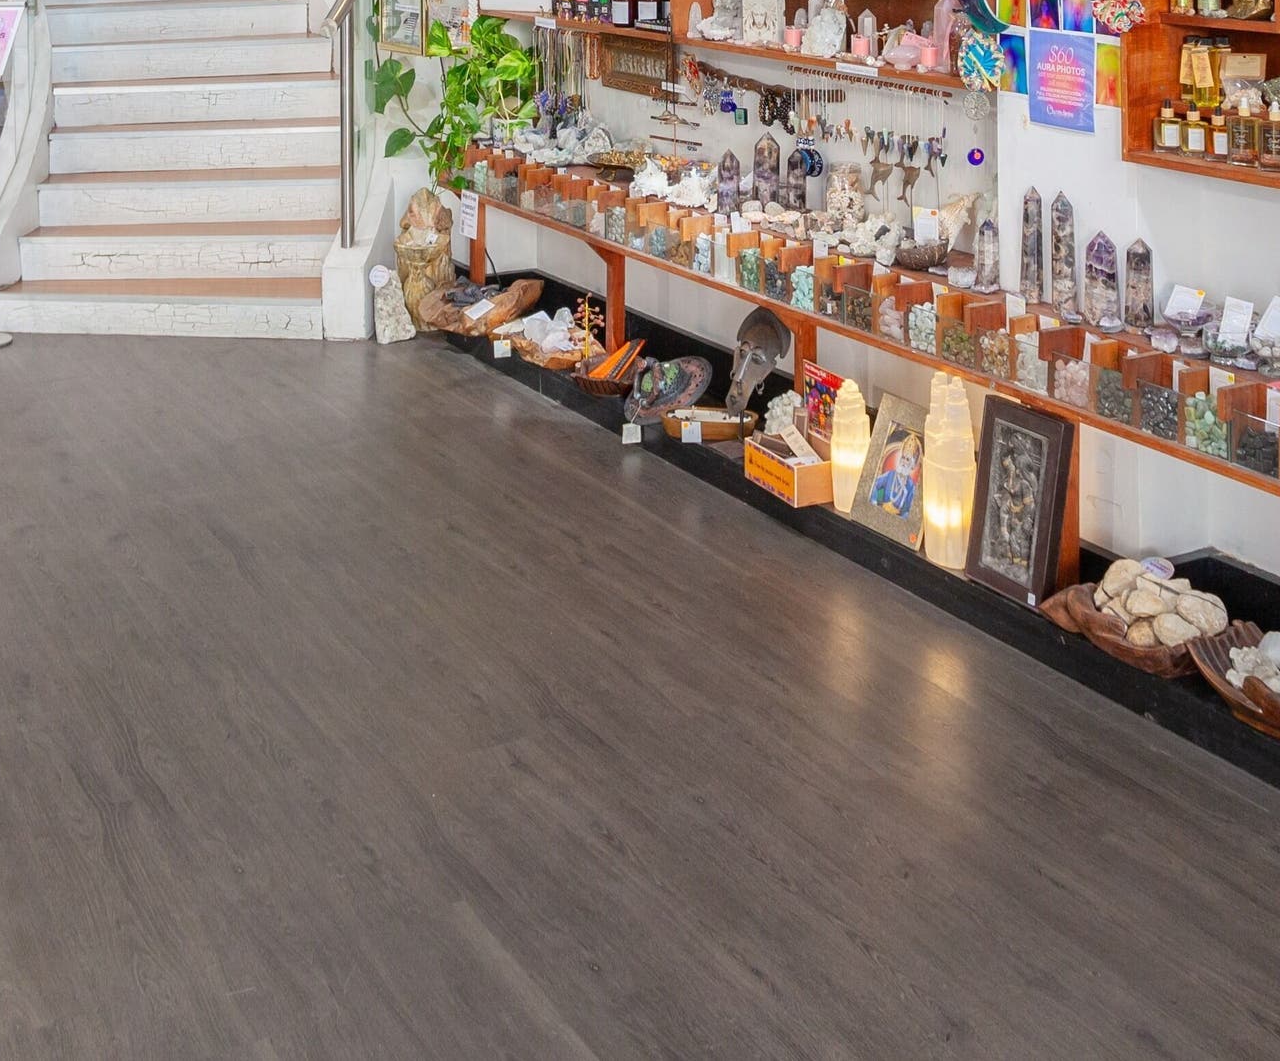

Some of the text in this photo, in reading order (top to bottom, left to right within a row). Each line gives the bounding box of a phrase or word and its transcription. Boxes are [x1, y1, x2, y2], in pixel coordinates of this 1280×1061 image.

[1049, 45, 1073, 64] $60
[1037, 63, 1086, 76] AURA PHOTOS
